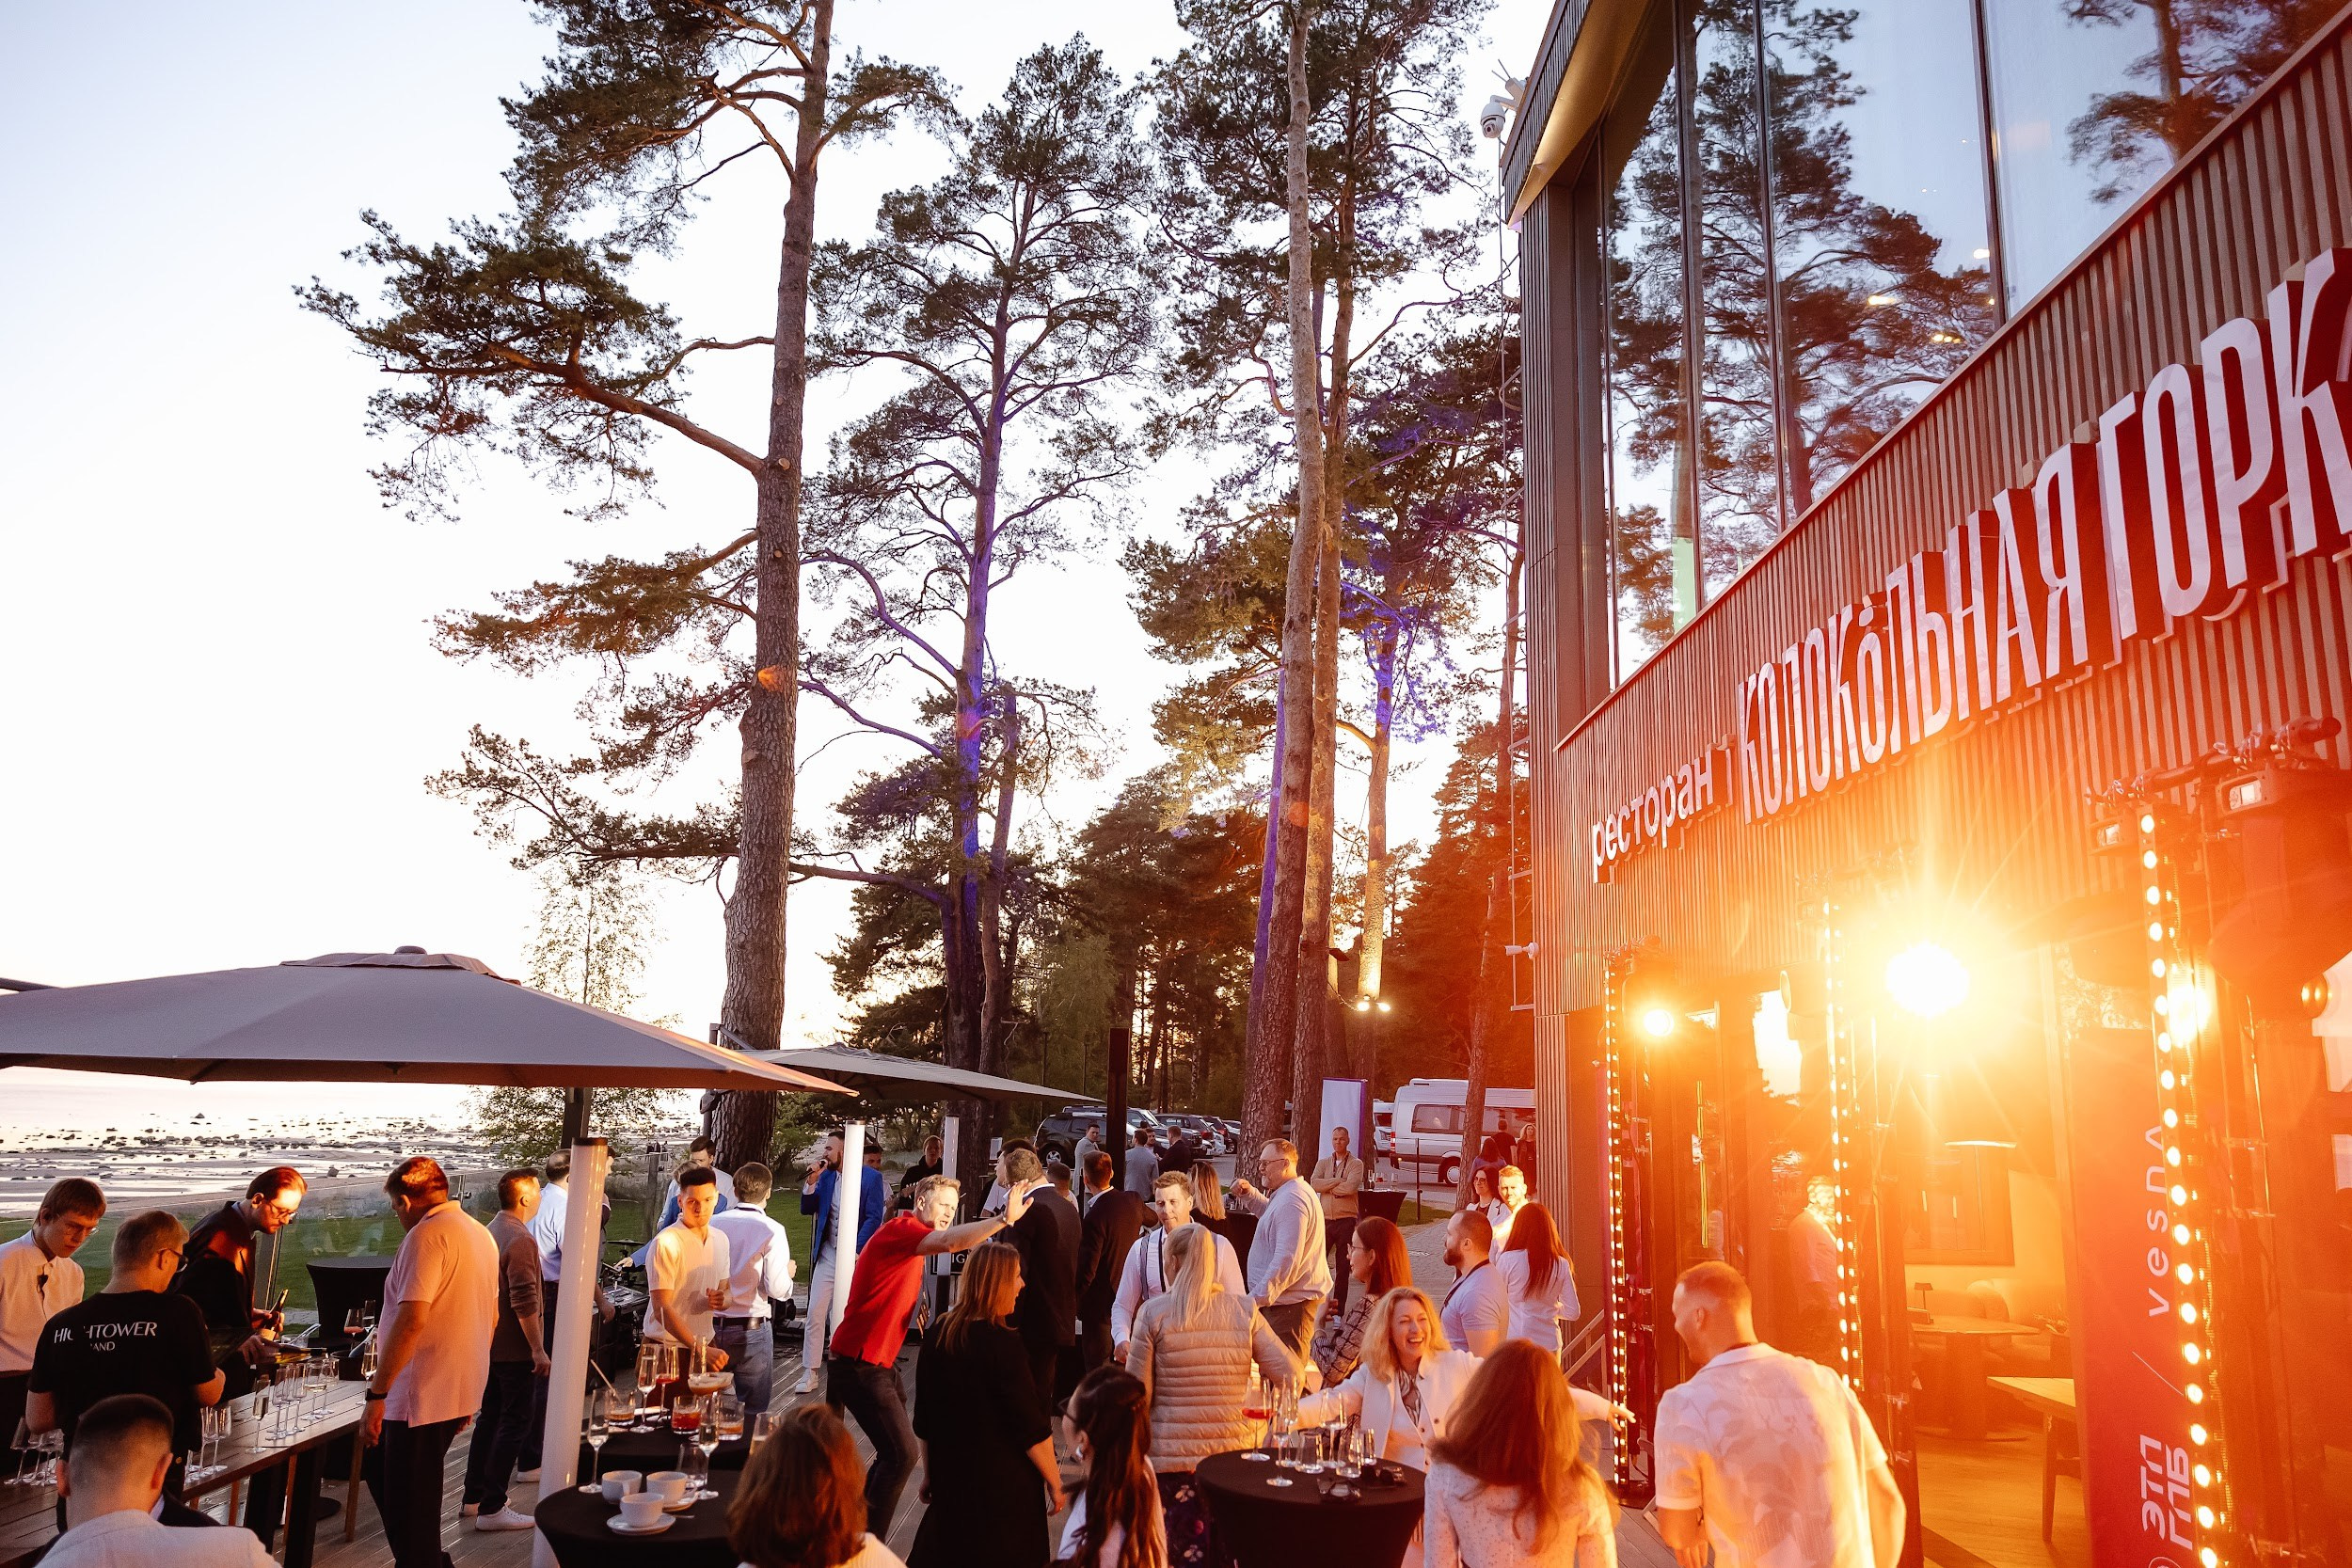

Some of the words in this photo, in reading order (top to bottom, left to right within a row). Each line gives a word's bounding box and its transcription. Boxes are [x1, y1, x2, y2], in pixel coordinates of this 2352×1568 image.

[1592, 749, 1713, 883] ресторан
[90, 1340, 116, 1352] AND
[2139, 1433, 2165, 1540] ЭТП
[2166, 1444, 2193, 1551] ГПБ
